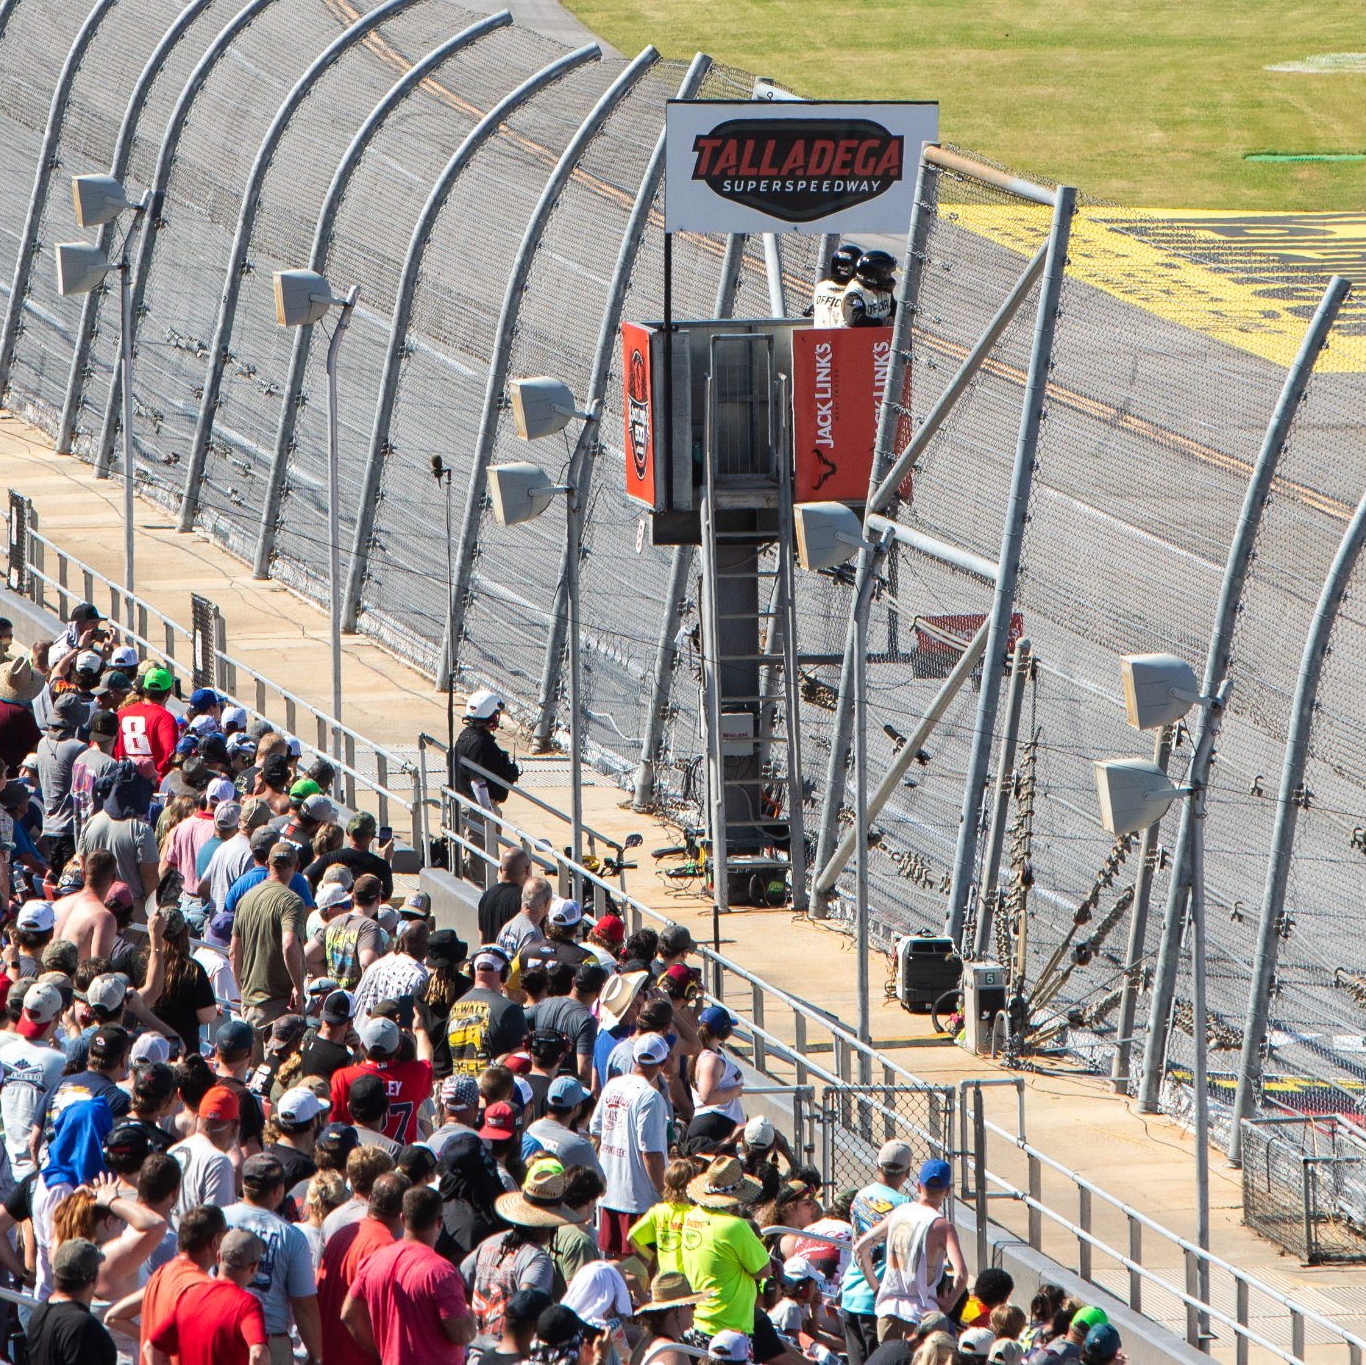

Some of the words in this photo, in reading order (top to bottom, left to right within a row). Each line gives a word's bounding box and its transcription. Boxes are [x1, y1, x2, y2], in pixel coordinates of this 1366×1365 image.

[697, 138, 902, 177] TALLADEGA
[722, 179, 882, 193] SUPERSPEEDWAY
[816, 295, 842, 308] OFFIC
[815, 342, 833, 399] LINK'S
[815, 400, 834, 449] JACK
[121, 716, 153, 755] 8
[986, 973, 994, 984] 5
